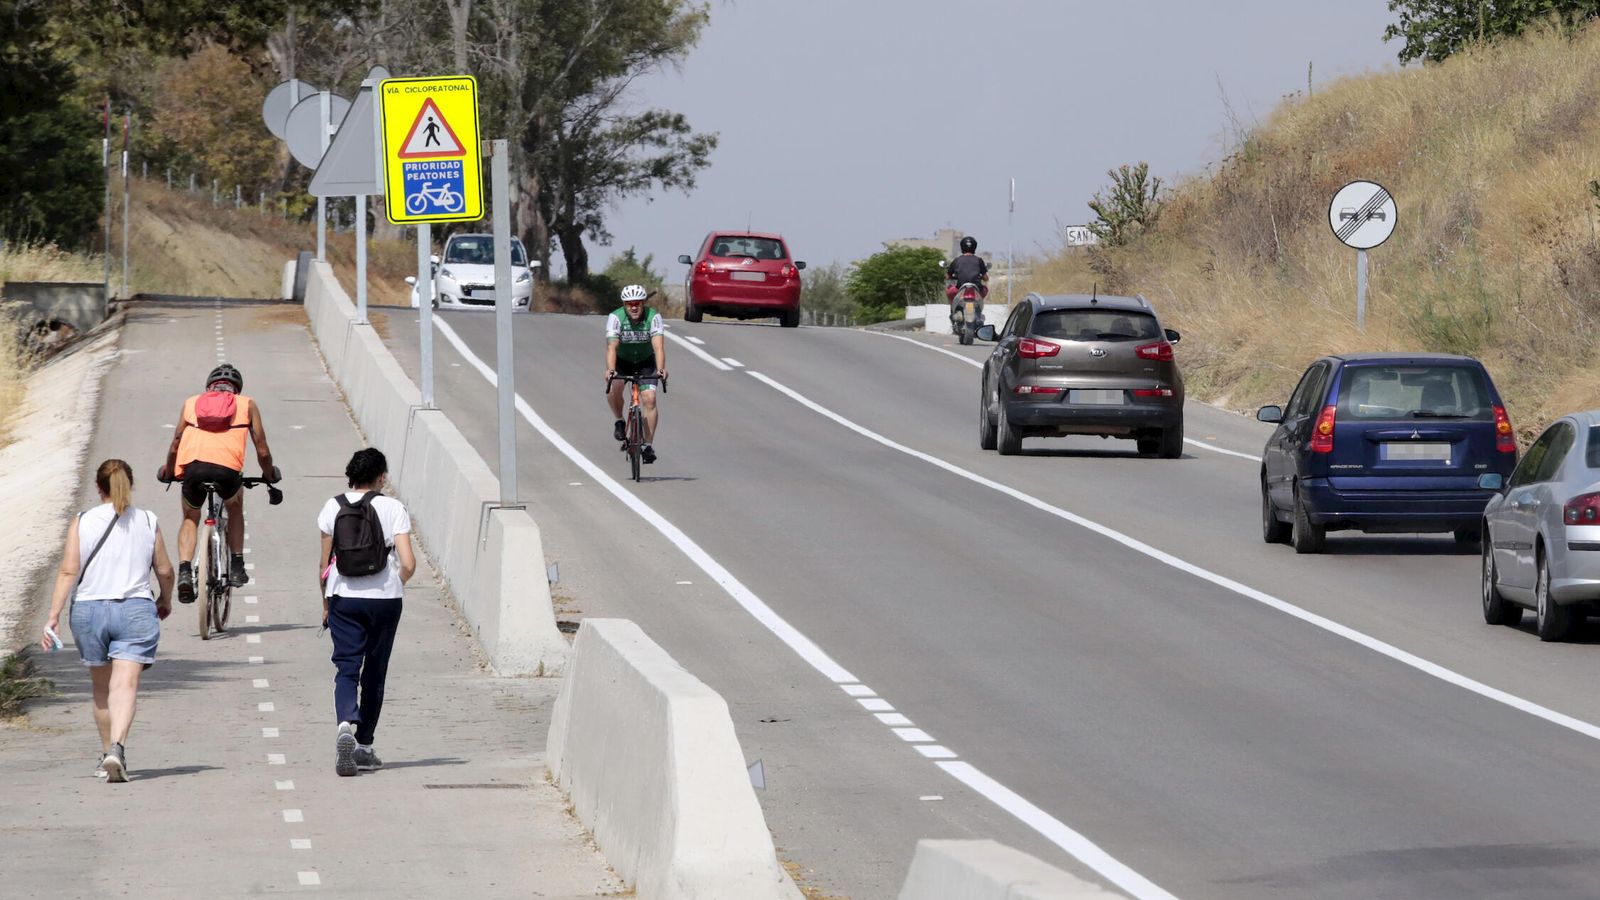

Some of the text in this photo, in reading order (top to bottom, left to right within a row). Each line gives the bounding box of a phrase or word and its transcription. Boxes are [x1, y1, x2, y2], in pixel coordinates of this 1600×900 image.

[404, 84, 470, 93] CICLOPEATONAL
[405, 161, 460, 171] PRIORIDAD
[407, 171, 460, 180] PEATONES
